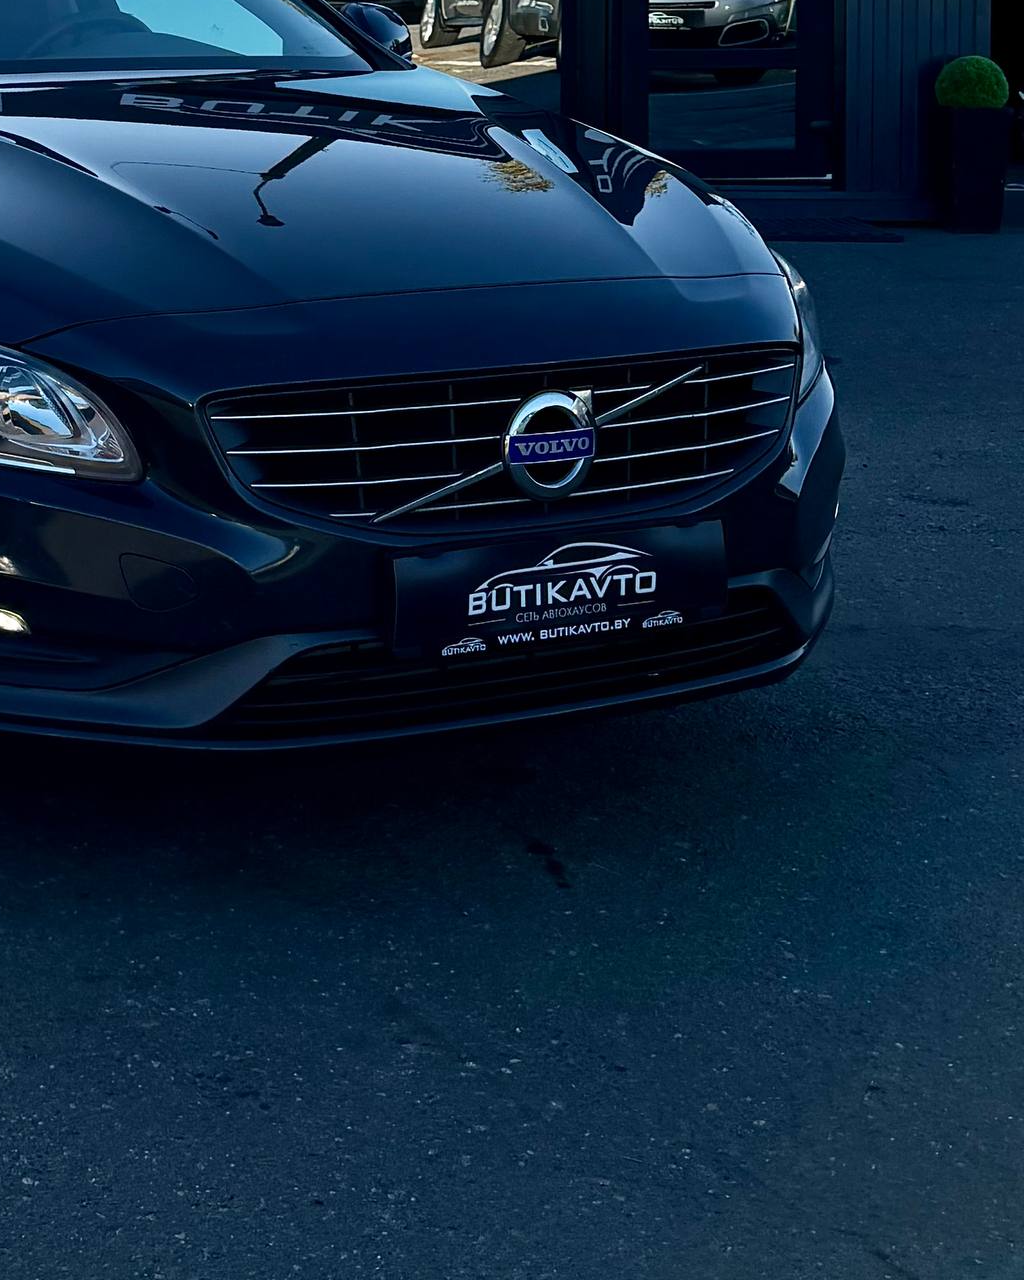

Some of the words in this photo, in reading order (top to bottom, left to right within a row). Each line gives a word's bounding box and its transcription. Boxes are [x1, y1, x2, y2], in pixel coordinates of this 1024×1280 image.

[514, 436, 590, 456] VOLVO
[467, 571, 656, 616] BUTIKAVTO
[515, 611, 540, 623] СЕТЬ
[542, 603, 607, 620] АВТОХАУСОВ
[642, 616, 683, 629] BUTIKAVTO
[497, 631, 535, 645] WWW.
[539, 618, 632, 640] BUTIKAVTO.BY
[441, 644, 486, 656] BUTIKAVTO
